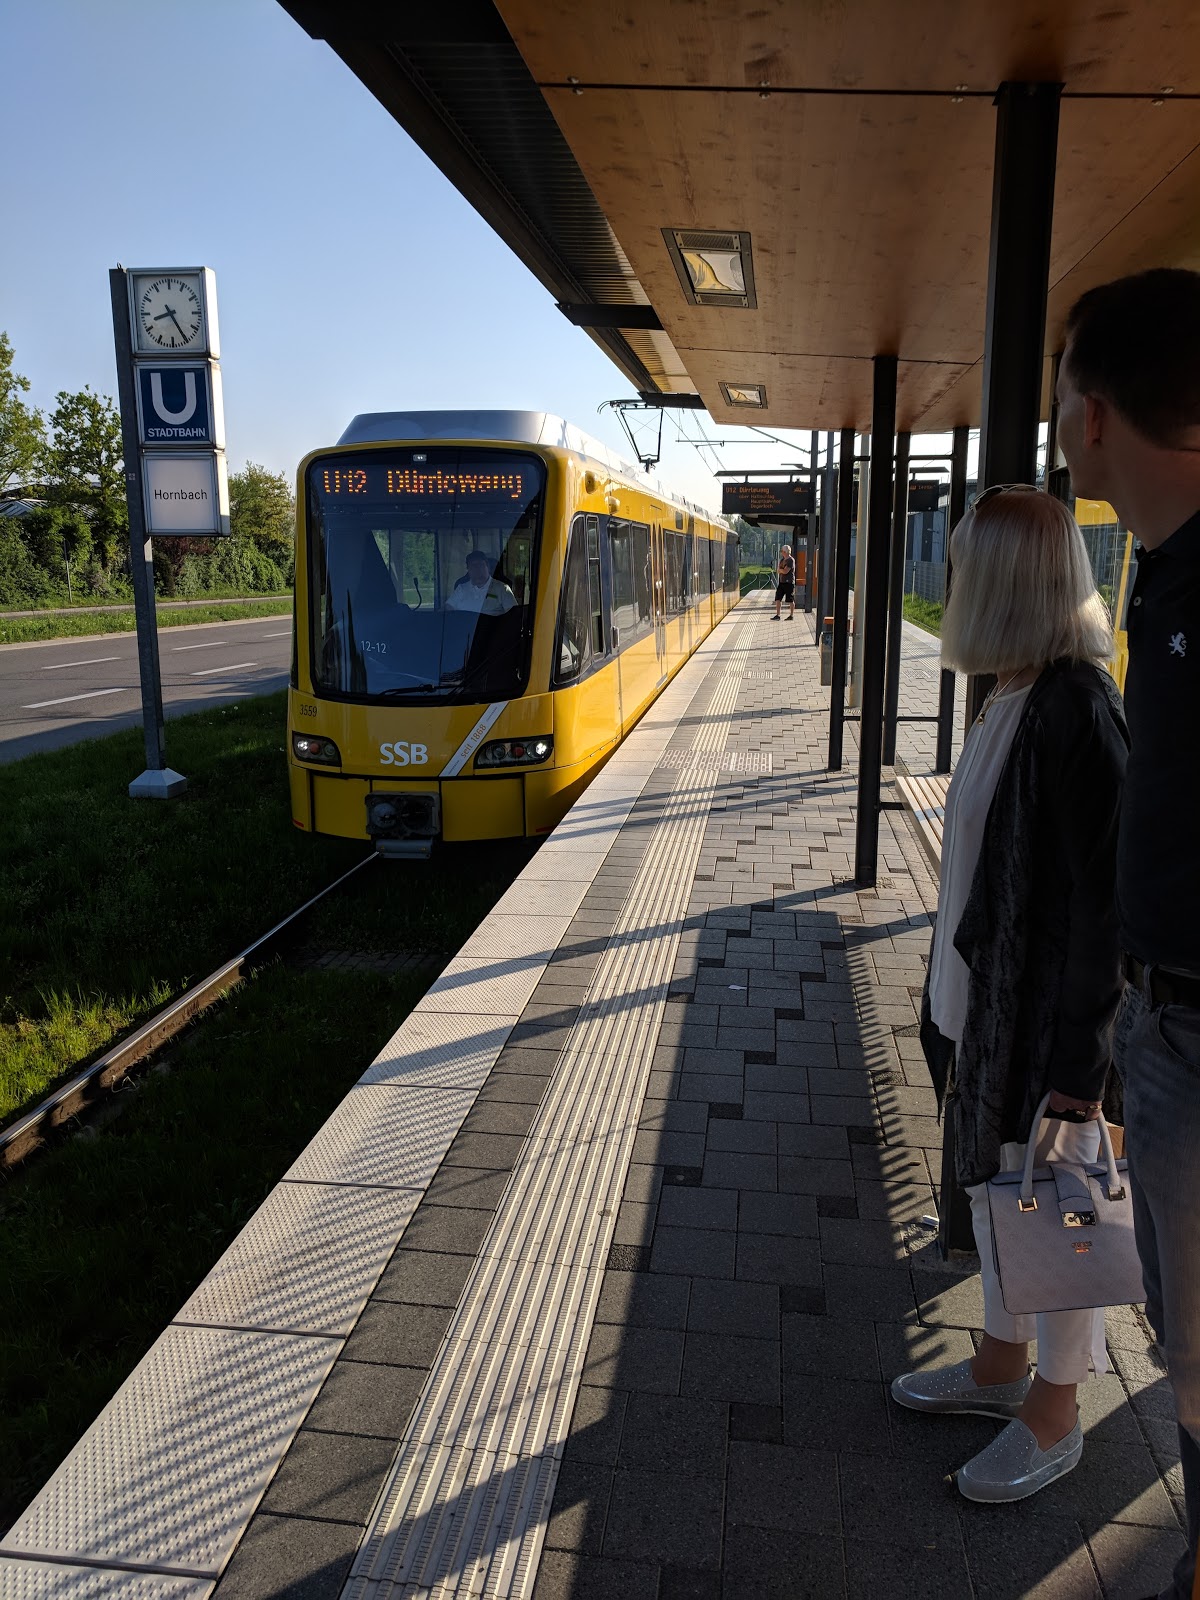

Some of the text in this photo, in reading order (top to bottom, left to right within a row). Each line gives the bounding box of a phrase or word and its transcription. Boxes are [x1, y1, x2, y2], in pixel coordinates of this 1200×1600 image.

[150, 372, 197, 425] U
[148, 427, 206, 438] STADTBAHN
[323, 470, 367, 493] U12
[154, 489, 208, 500] Hornbach
[360, 640, 387, 654] 12-12
[299, 704, 318, 718] 3559
[460, 724, 487, 759] seit 1868
[379, 741, 428, 766] SSB
